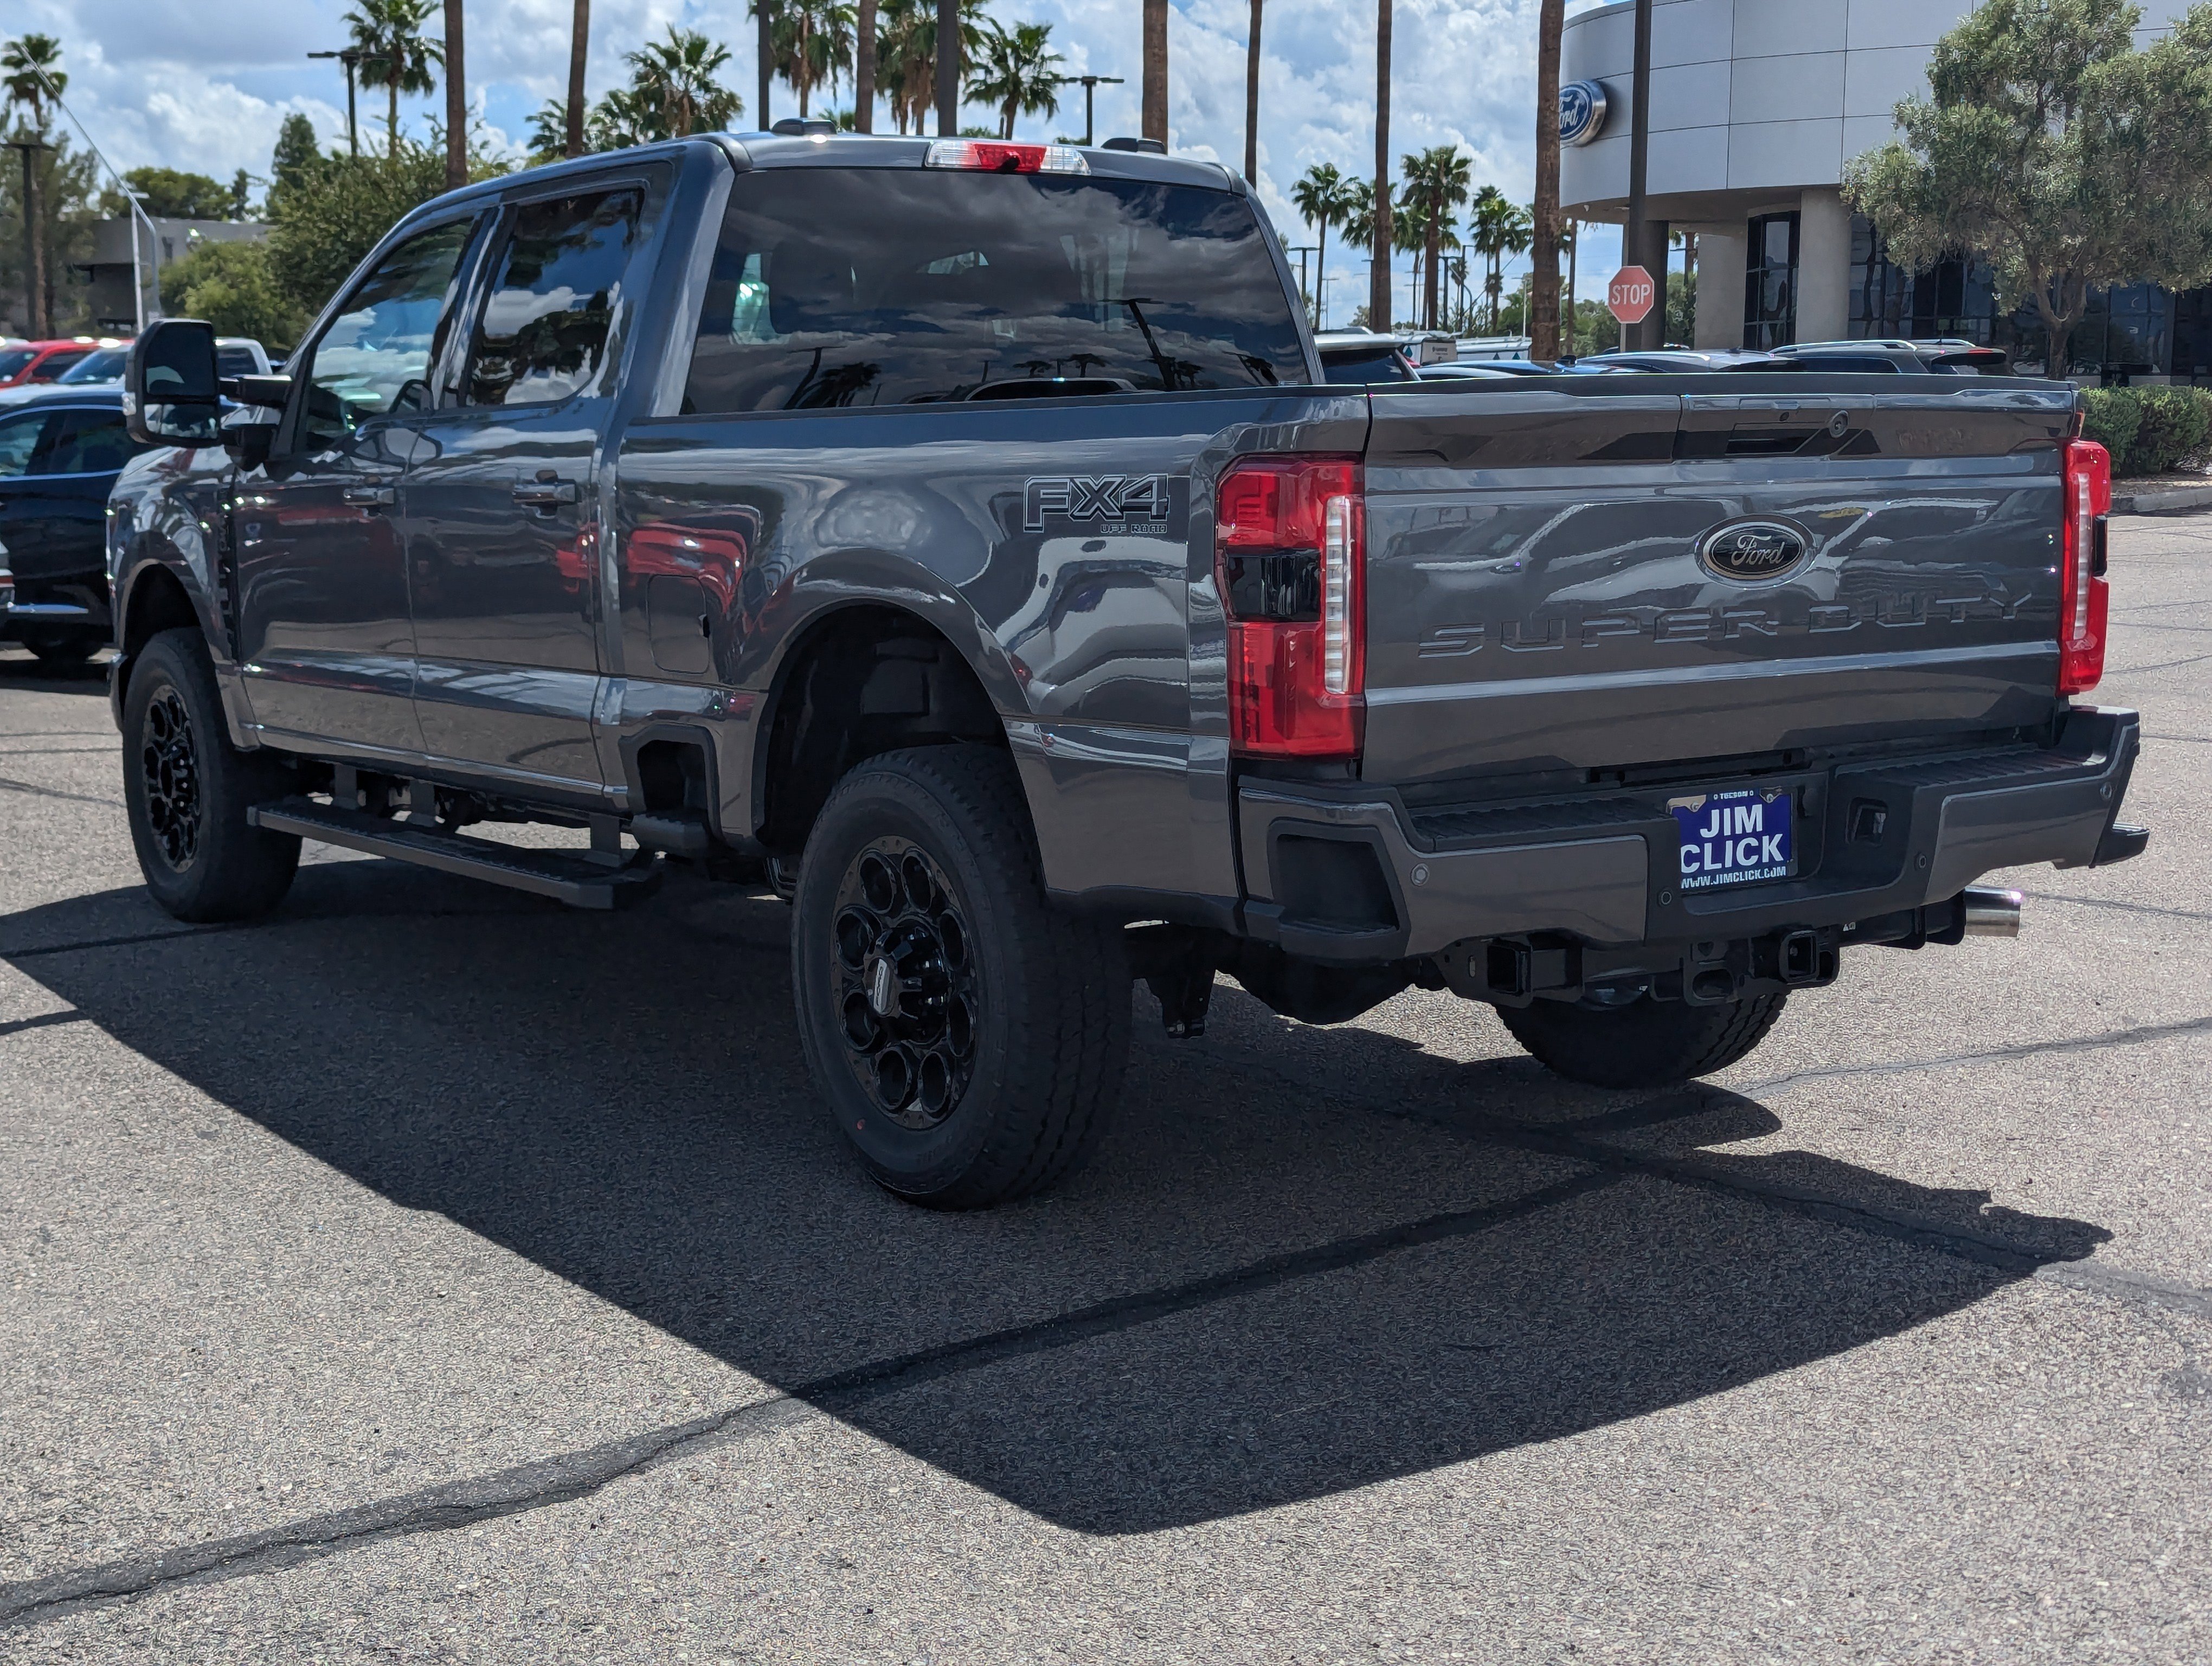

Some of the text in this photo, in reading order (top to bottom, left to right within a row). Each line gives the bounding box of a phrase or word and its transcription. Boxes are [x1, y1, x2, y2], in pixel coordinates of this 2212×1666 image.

[1612, 284, 1651, 305] STOP
[1023, 473, 1170, 534] FX4
[1130, 524, 1167, 534] ROAD
[1731, 534, 1785, 566] Ford
[1417, 591, 2033, 658] SUPER DUTY
[1700, 803, 1763, 838] JIM
[1681, 833, 1784, 874] CLICK
[1681, 866, 1786, 888] WWW.JIMCLICK.COM
